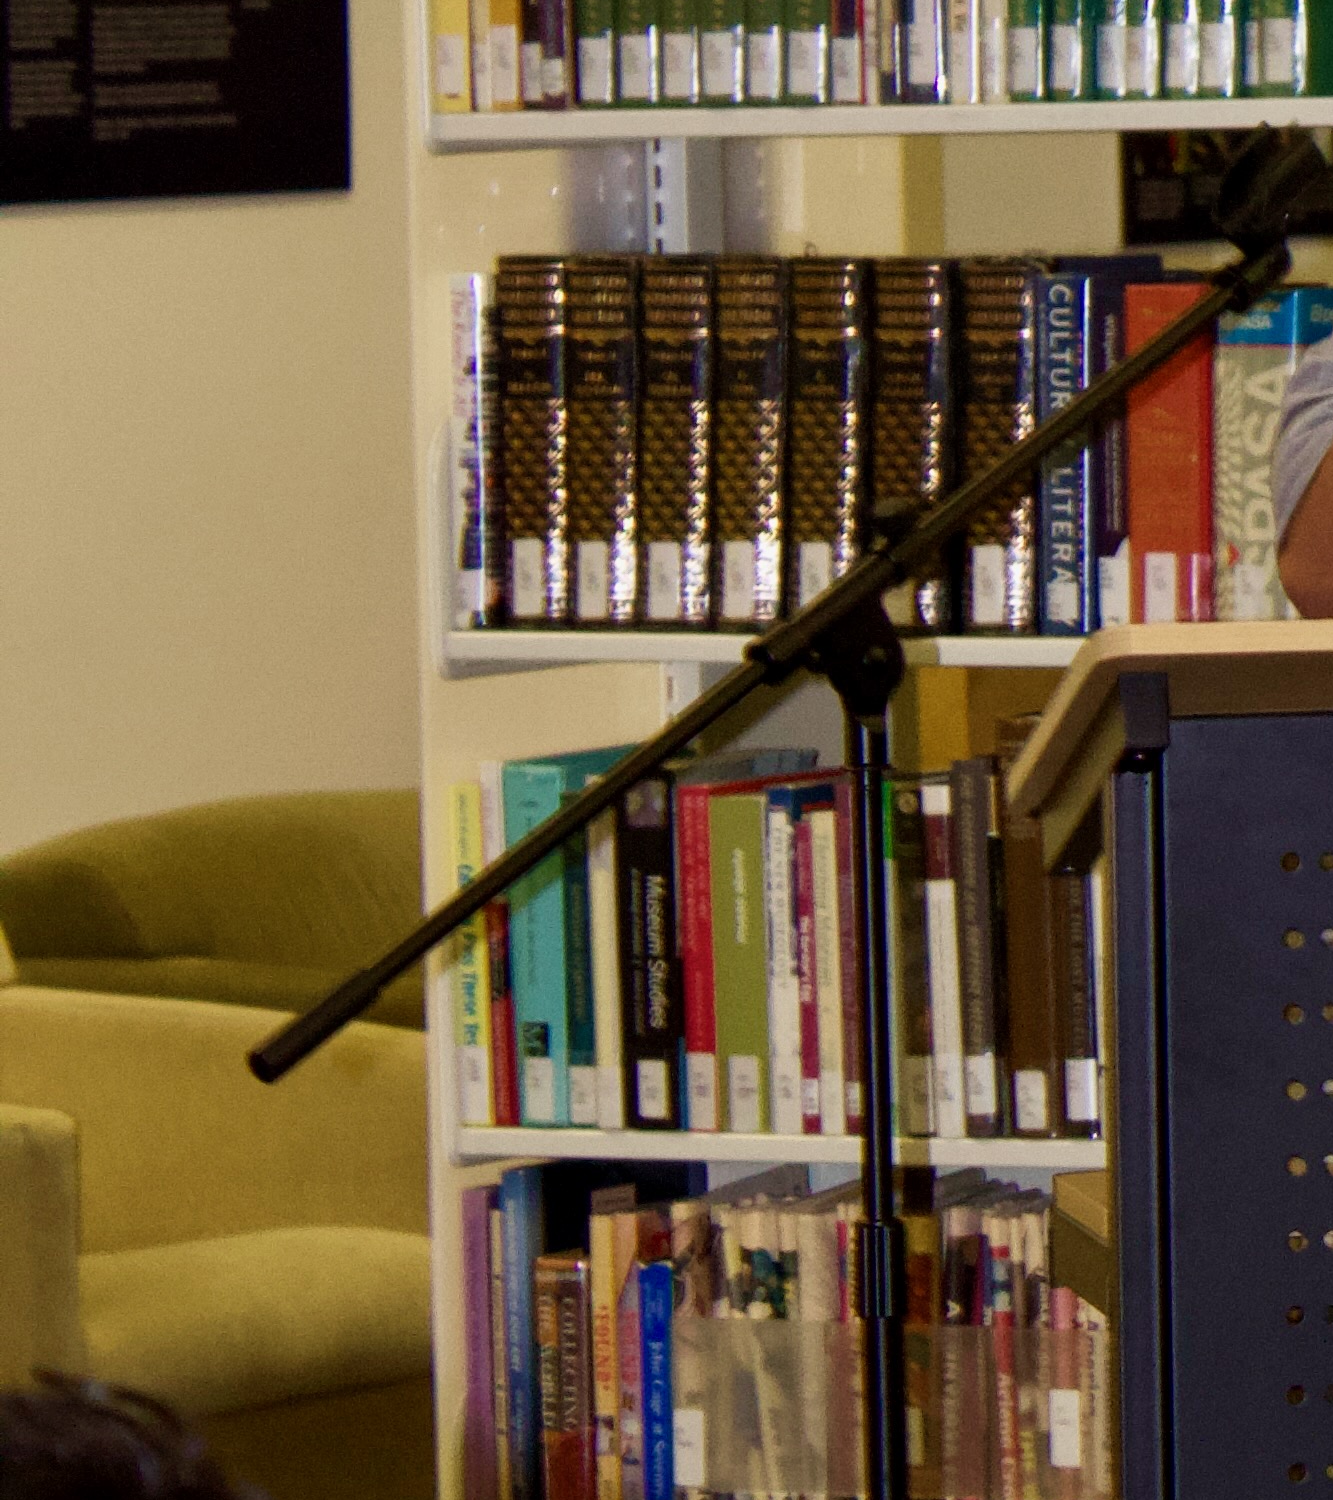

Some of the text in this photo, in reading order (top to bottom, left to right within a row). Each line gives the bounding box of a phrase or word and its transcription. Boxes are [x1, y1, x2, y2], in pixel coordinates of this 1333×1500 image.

[1047, 284, 1075, 625] CULTUR LITERAY
[644, 875, 666, 1029] Museum Studies
